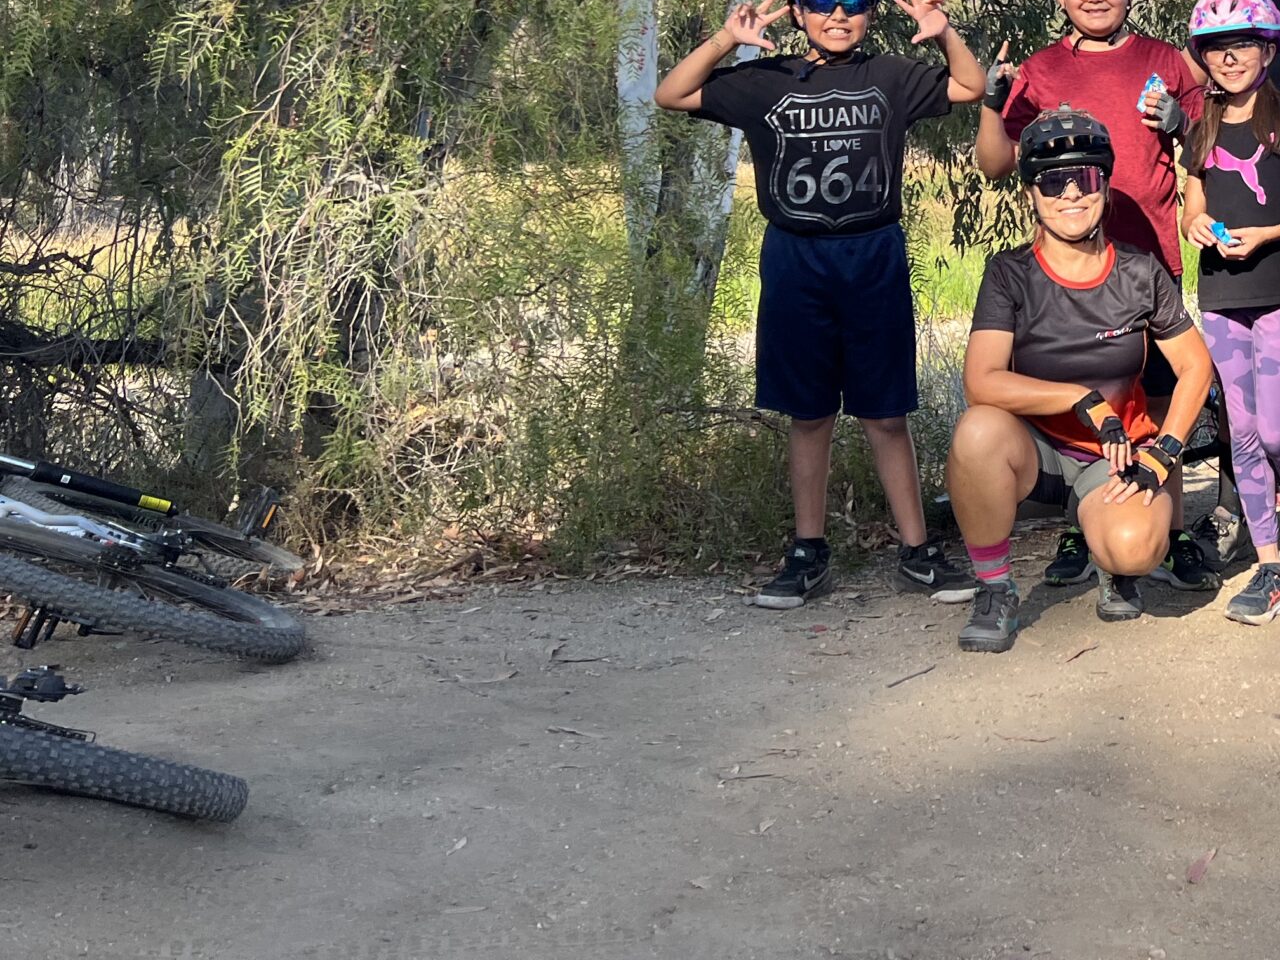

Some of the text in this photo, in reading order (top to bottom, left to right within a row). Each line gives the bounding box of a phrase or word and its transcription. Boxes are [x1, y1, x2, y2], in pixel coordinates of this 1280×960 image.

[785, 104, 883, 130] TIJUANA
[811, 140, 818, 153] I
[786, 155, 882, 205] 664
